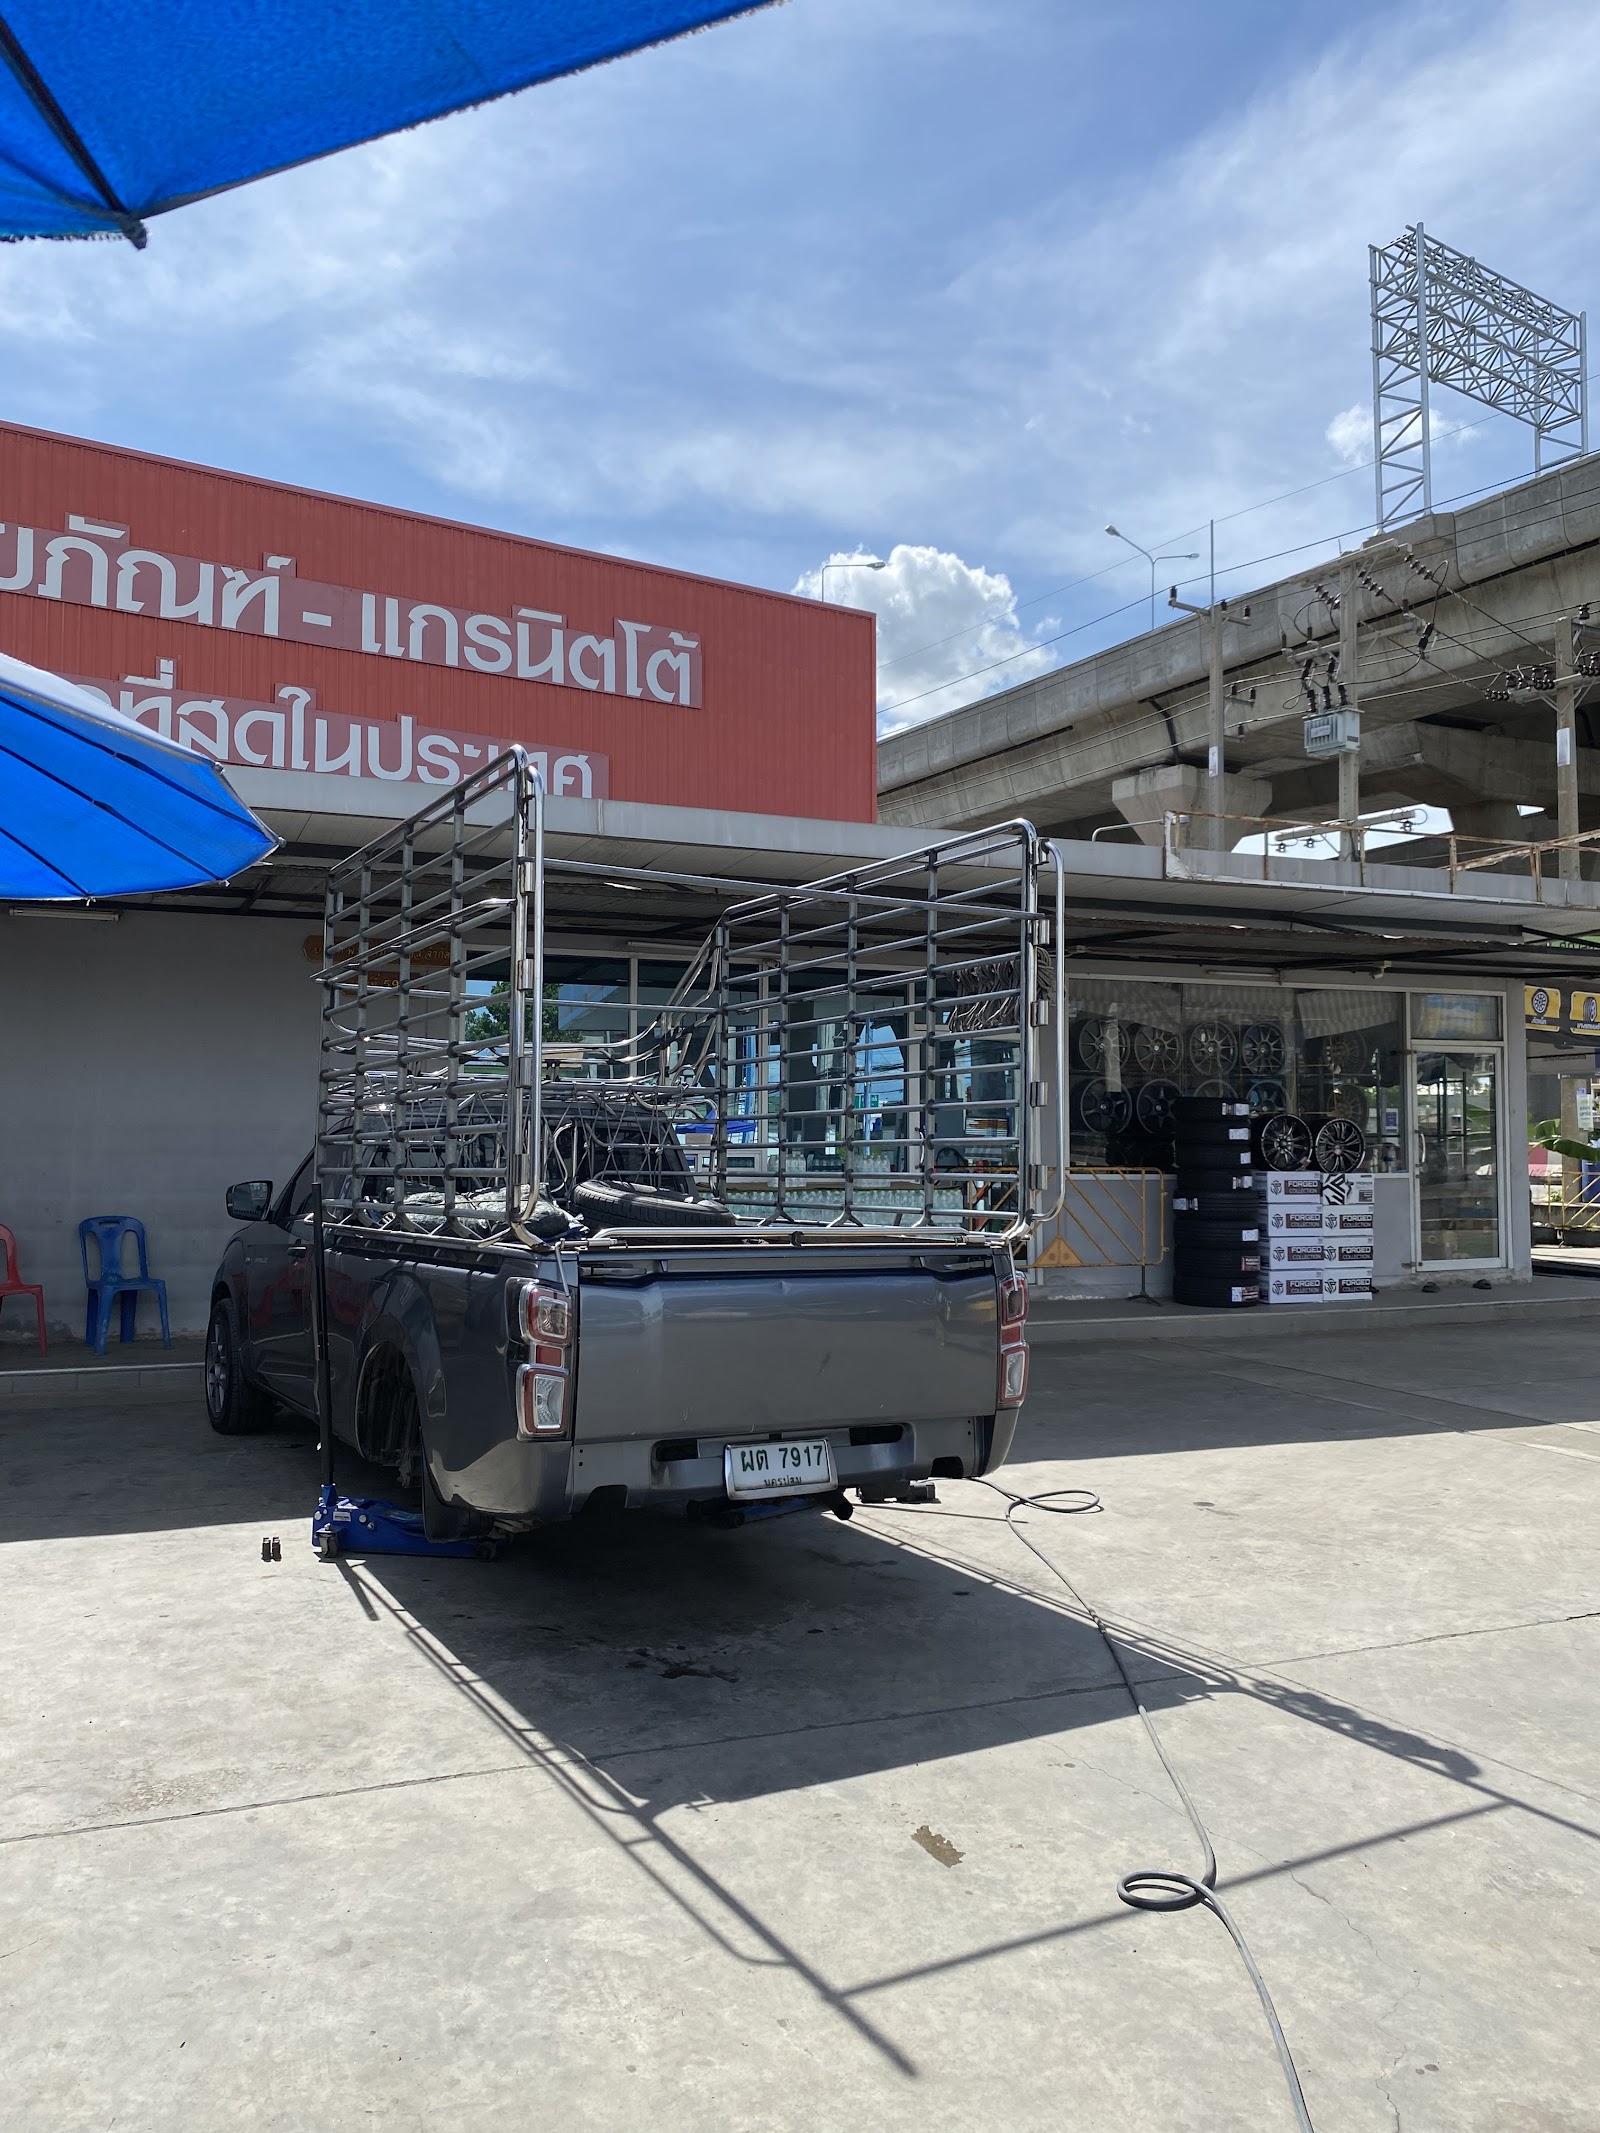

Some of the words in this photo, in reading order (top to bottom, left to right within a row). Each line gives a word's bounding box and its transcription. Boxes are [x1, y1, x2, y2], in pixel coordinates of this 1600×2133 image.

[361, 592, 699, 706] แกรนิตโต้
[778, 1445, 823, 1469] 7917
